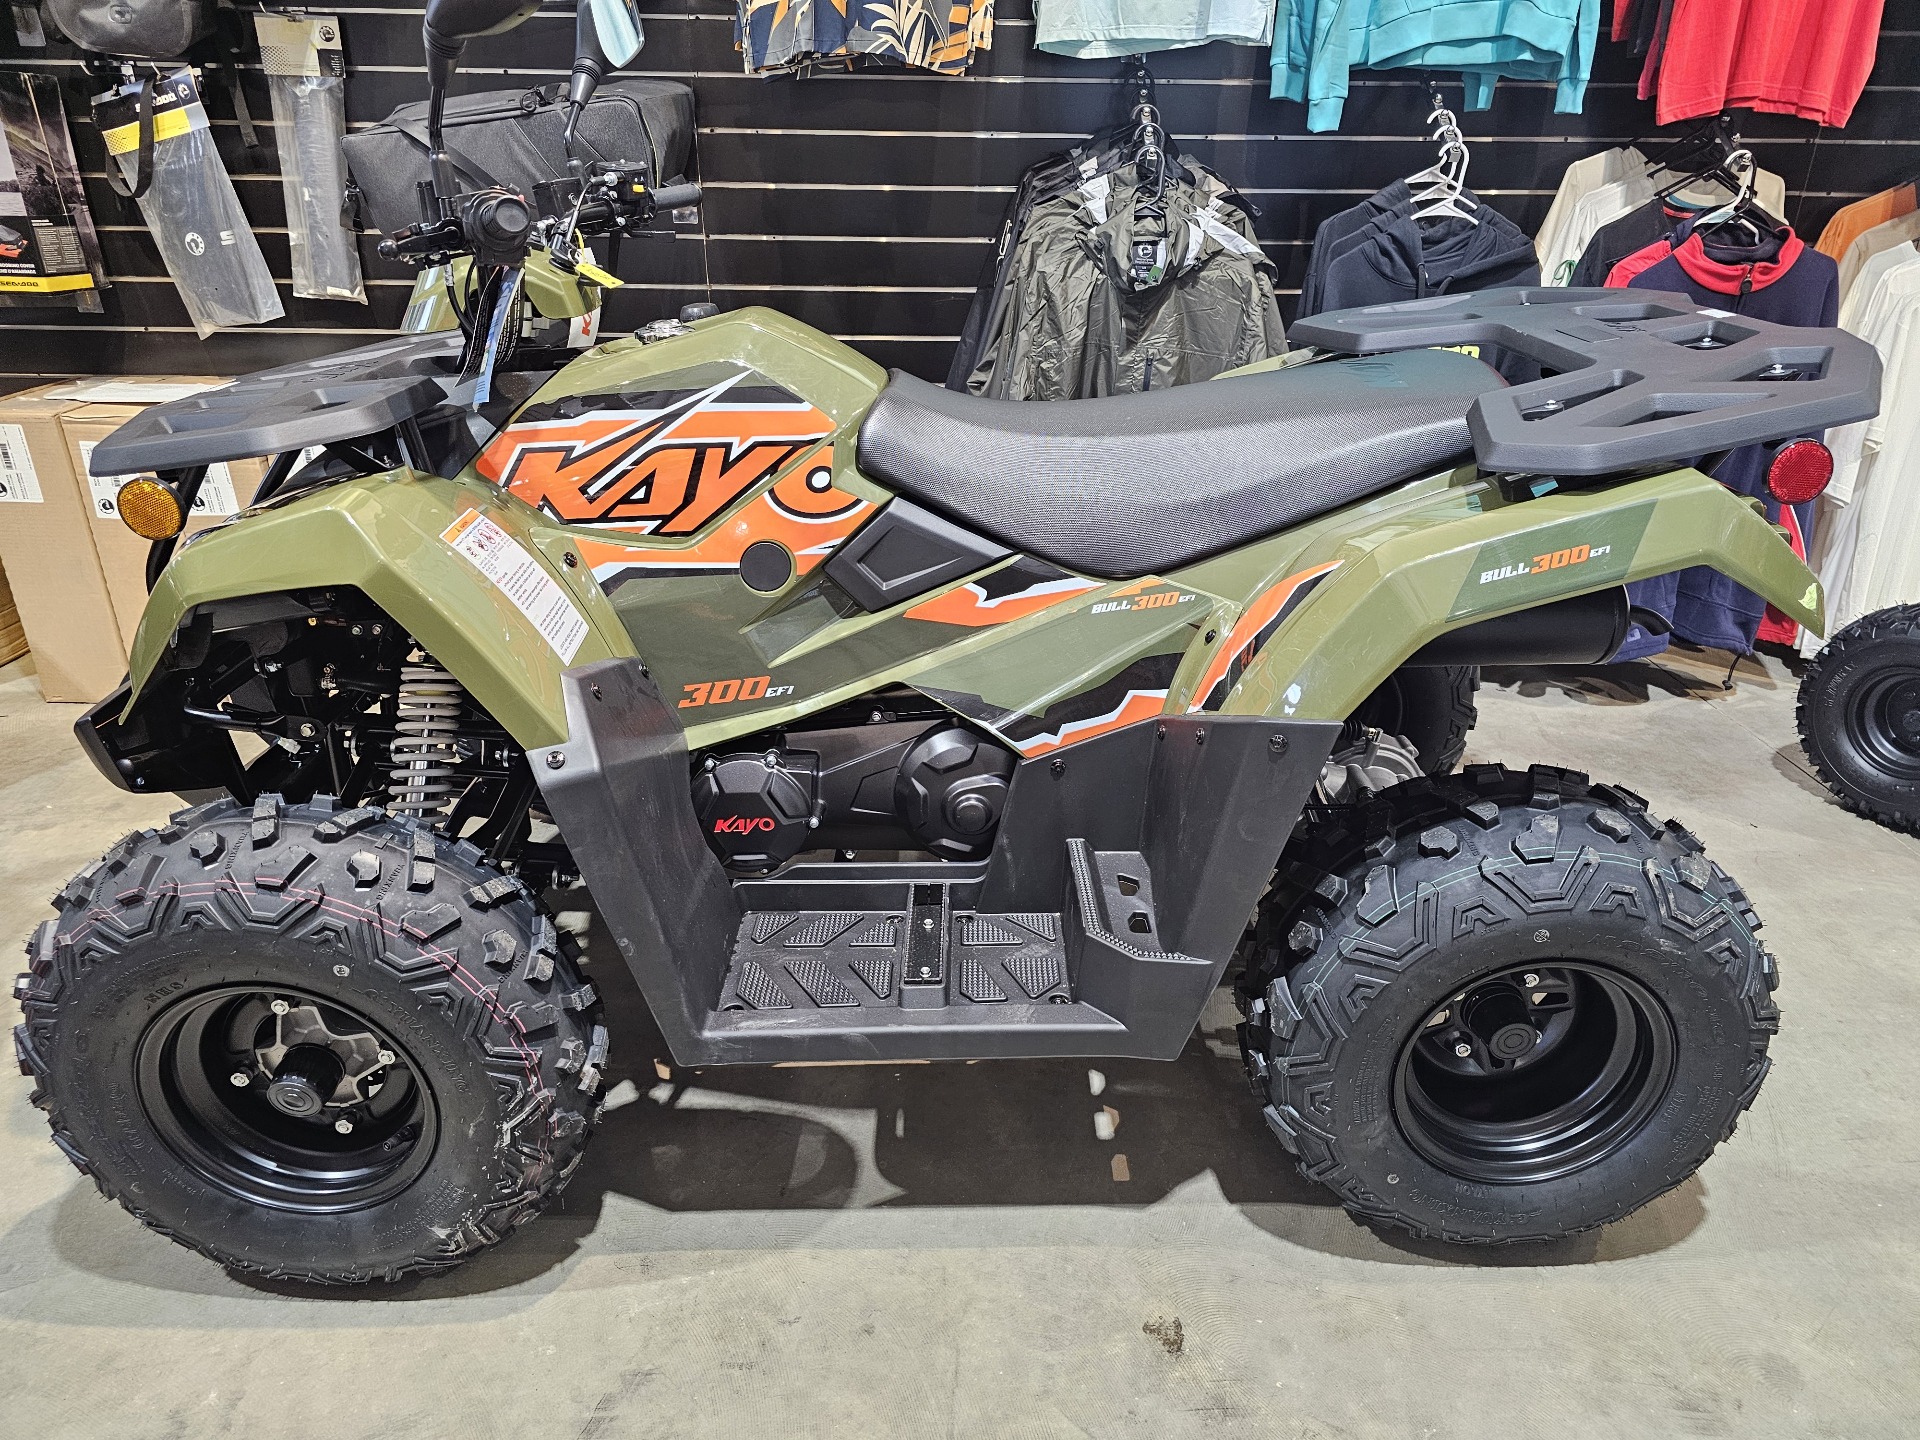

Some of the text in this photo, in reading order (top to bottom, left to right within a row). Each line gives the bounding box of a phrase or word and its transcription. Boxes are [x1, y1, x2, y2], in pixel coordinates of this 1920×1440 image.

[503, 416, 866, 536] KAYO
[1480, 544, 1611, 585] BULL 300 EFI
[1091, 600, 1132, 615] BULL
[1131, 591, 1180, 611] 300
[677, 675, 795, 708] 300 EFI
[713, 814, 776, 836] KAYO
